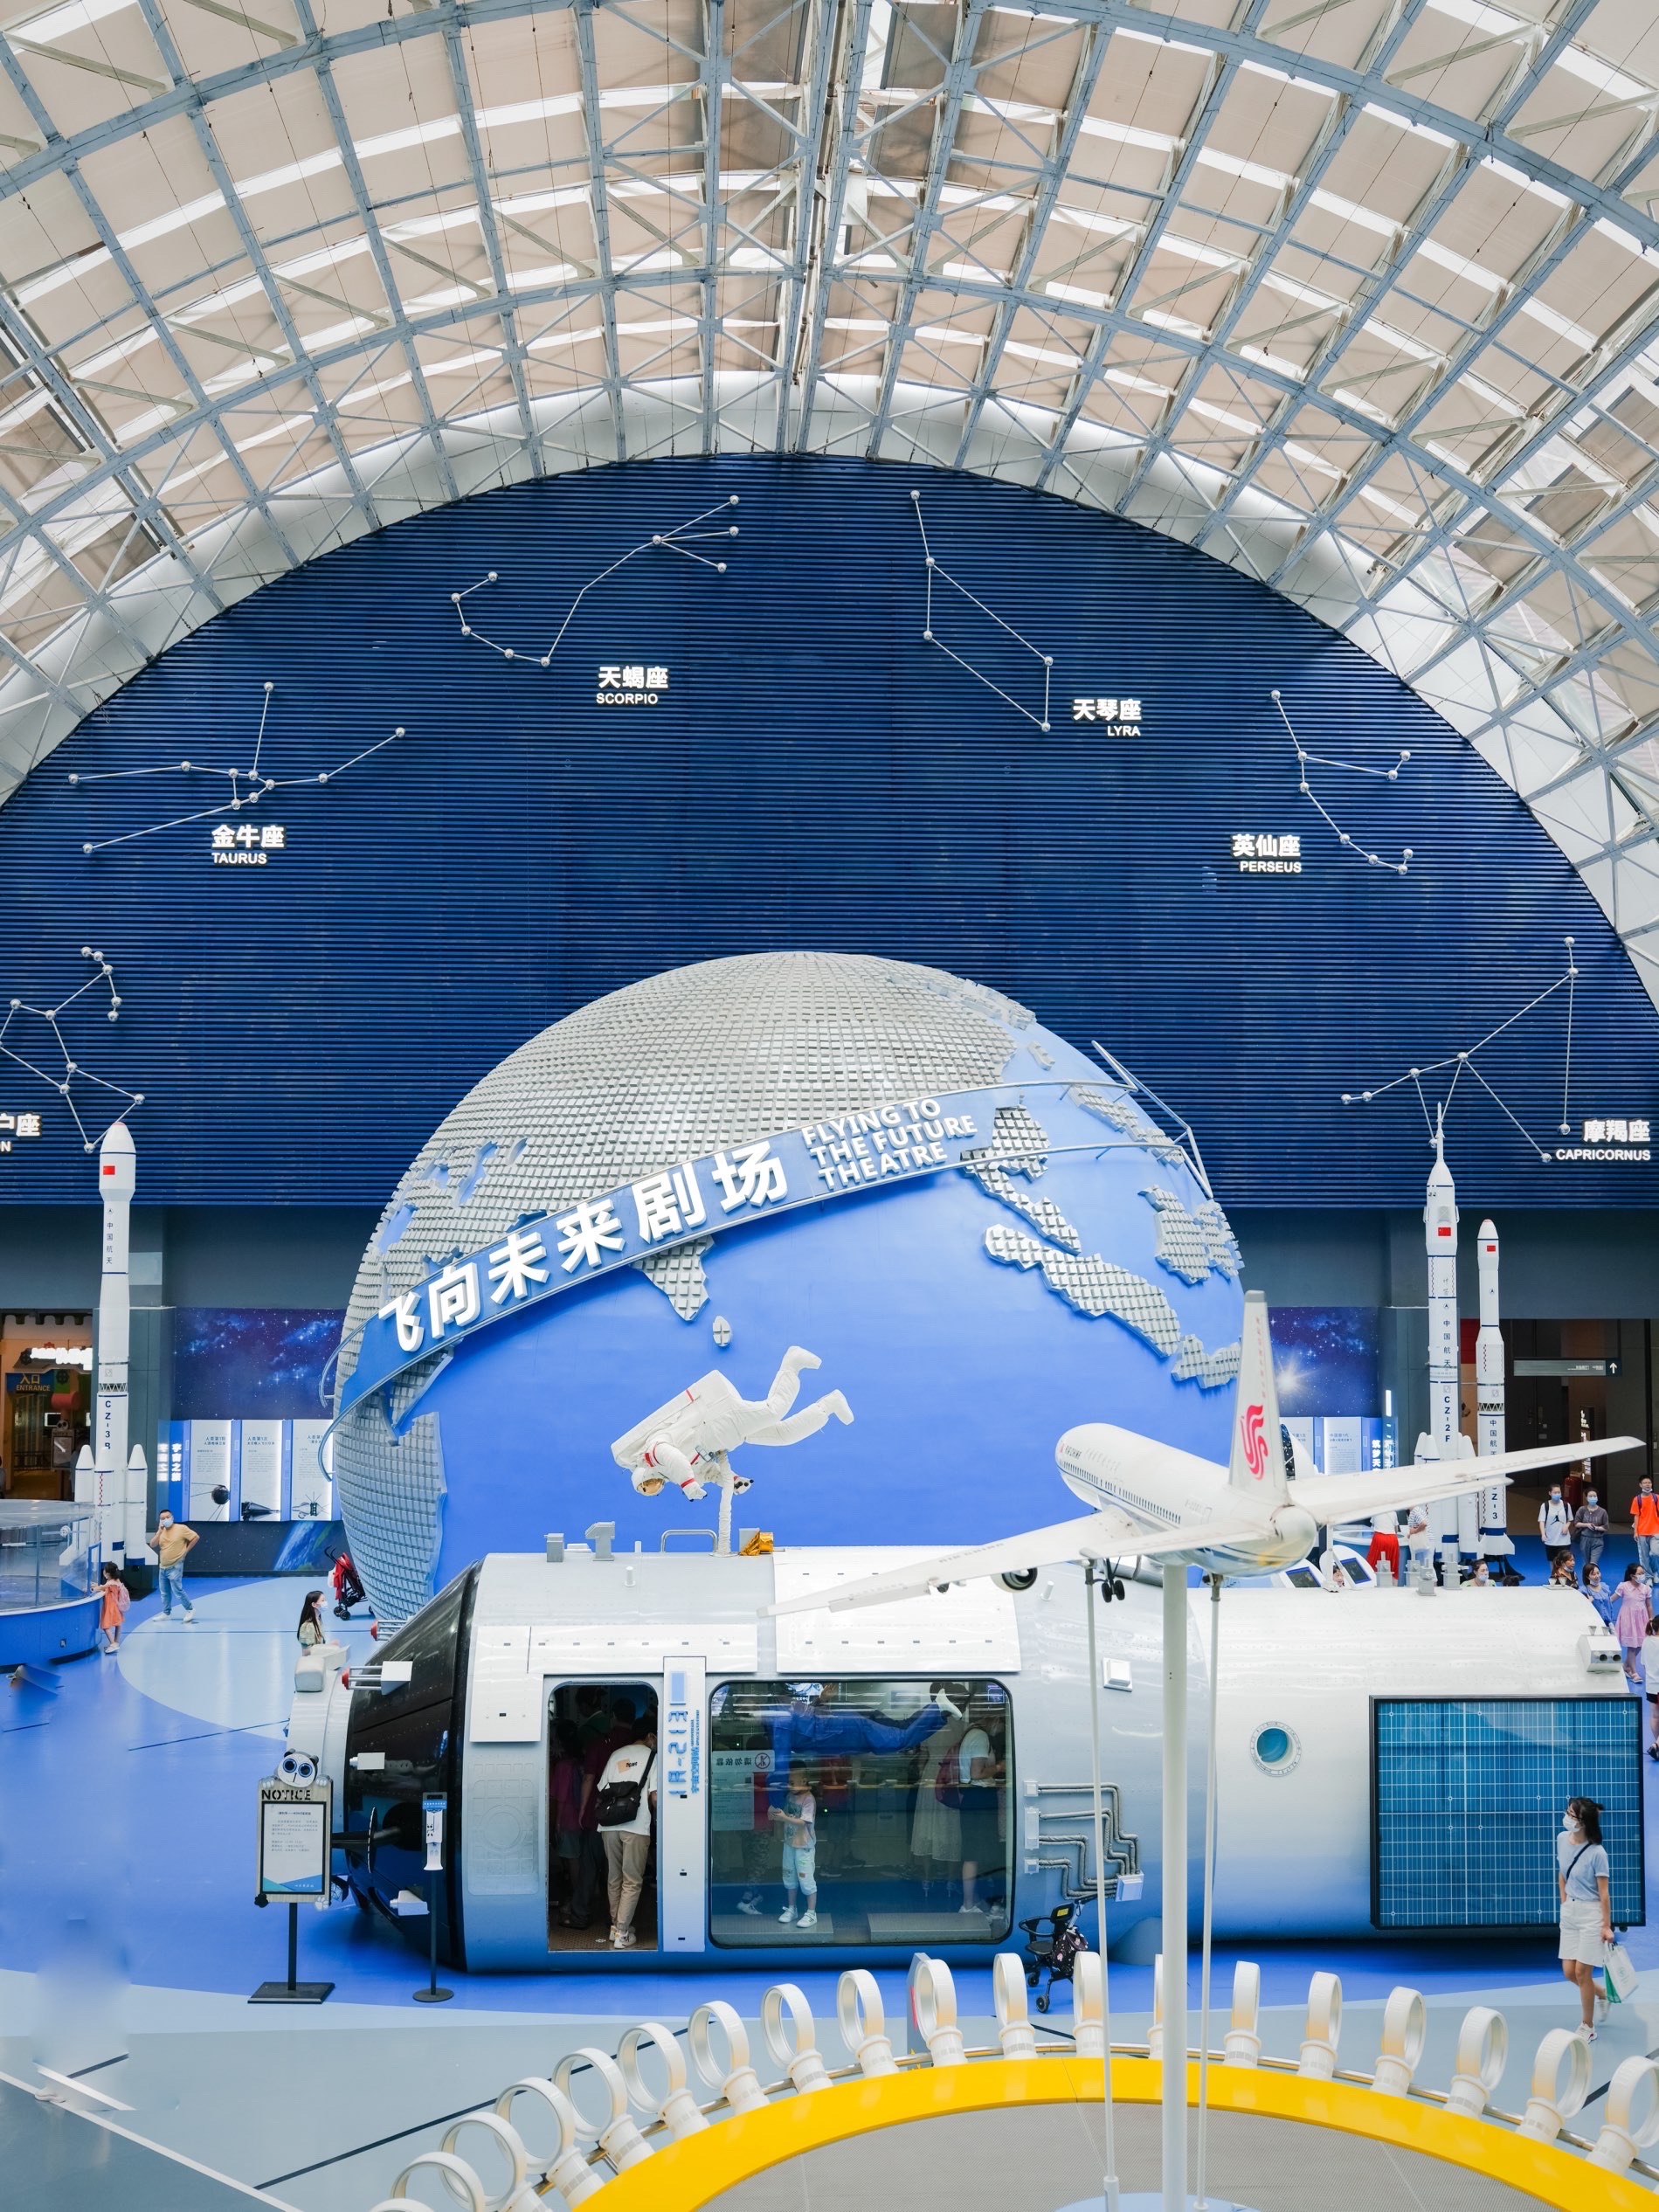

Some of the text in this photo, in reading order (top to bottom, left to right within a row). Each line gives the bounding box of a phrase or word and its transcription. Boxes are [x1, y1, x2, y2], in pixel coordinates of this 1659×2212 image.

[598, 666, 668, 688] 天蝎座
[596, 693, 658, 704] SCORPIO
[1073, 698, 1142, 721] 天琴座
[1107, 725, 1141, 736] LYRA
[211, 825, 285, 847] 金牛座
[1232, 833, 1301, 857] 英仙座
[211, 853, 267, 864] TAURUS
[1240, 861, 1302, 873] PERSEUS
[801, 1098, 941, 1148] FLYING TO
[1583, 1119, 1651, 1142] 摩羯座
[810, 1115, 978, 1168] THE FUTURE
[1555, 1149, 1651, 1160] CAPRICORNUS
[819, 1141, 948, 1192] THEATRE
[378, 1141, 788, 1352] 飞向未来剧场
[20, 1373, 40, 1384] 入口
[262, 1789, 311, 1801] NOTICE
